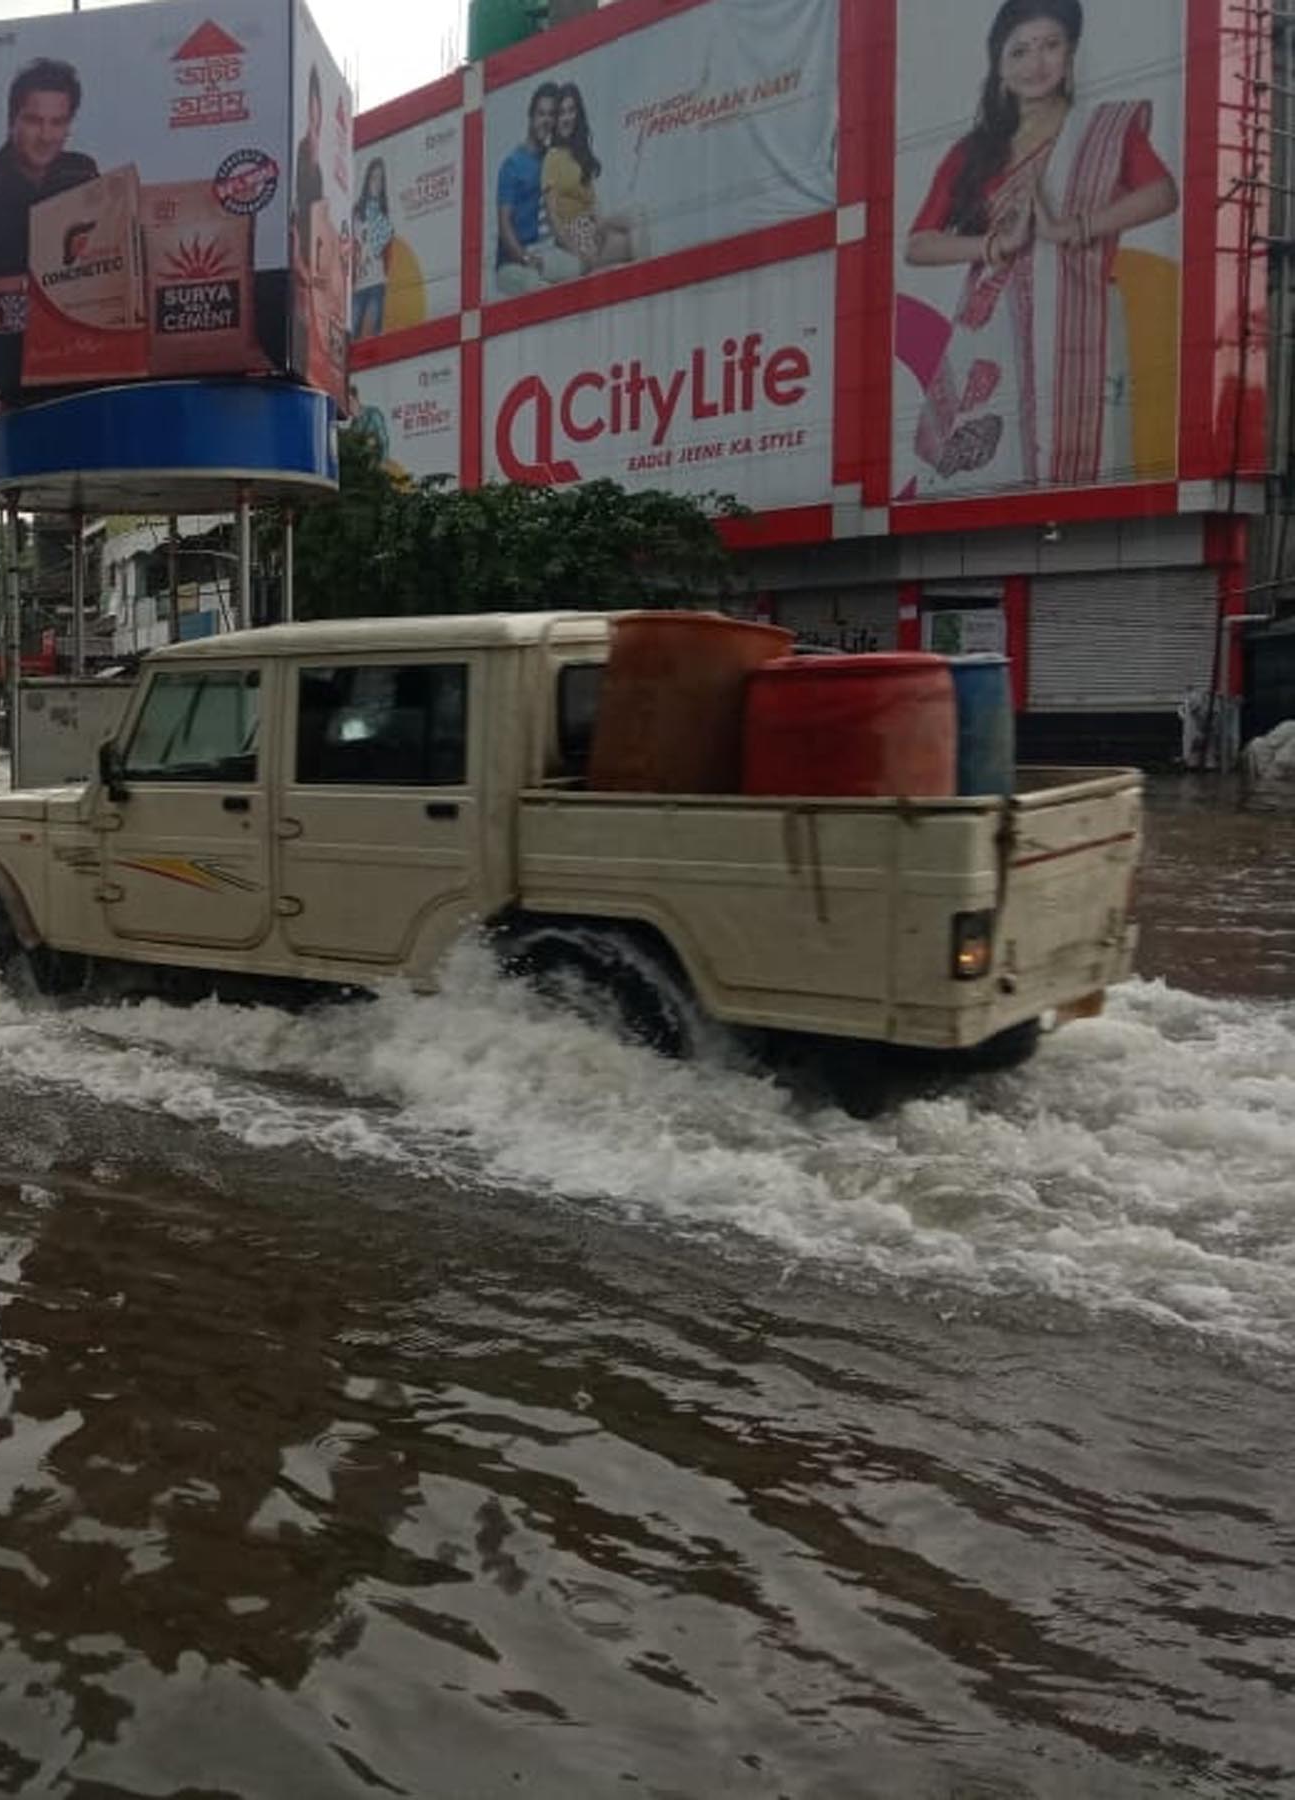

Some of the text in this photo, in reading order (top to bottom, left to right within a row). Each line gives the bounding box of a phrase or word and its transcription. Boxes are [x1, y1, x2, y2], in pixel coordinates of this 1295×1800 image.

[163, 285, 232, 306] SURYA
[163, 309, 233, 331] CEMENT
[560, 333, 812, 446] CityLife
[758, 429, 808, 451] STYLE
